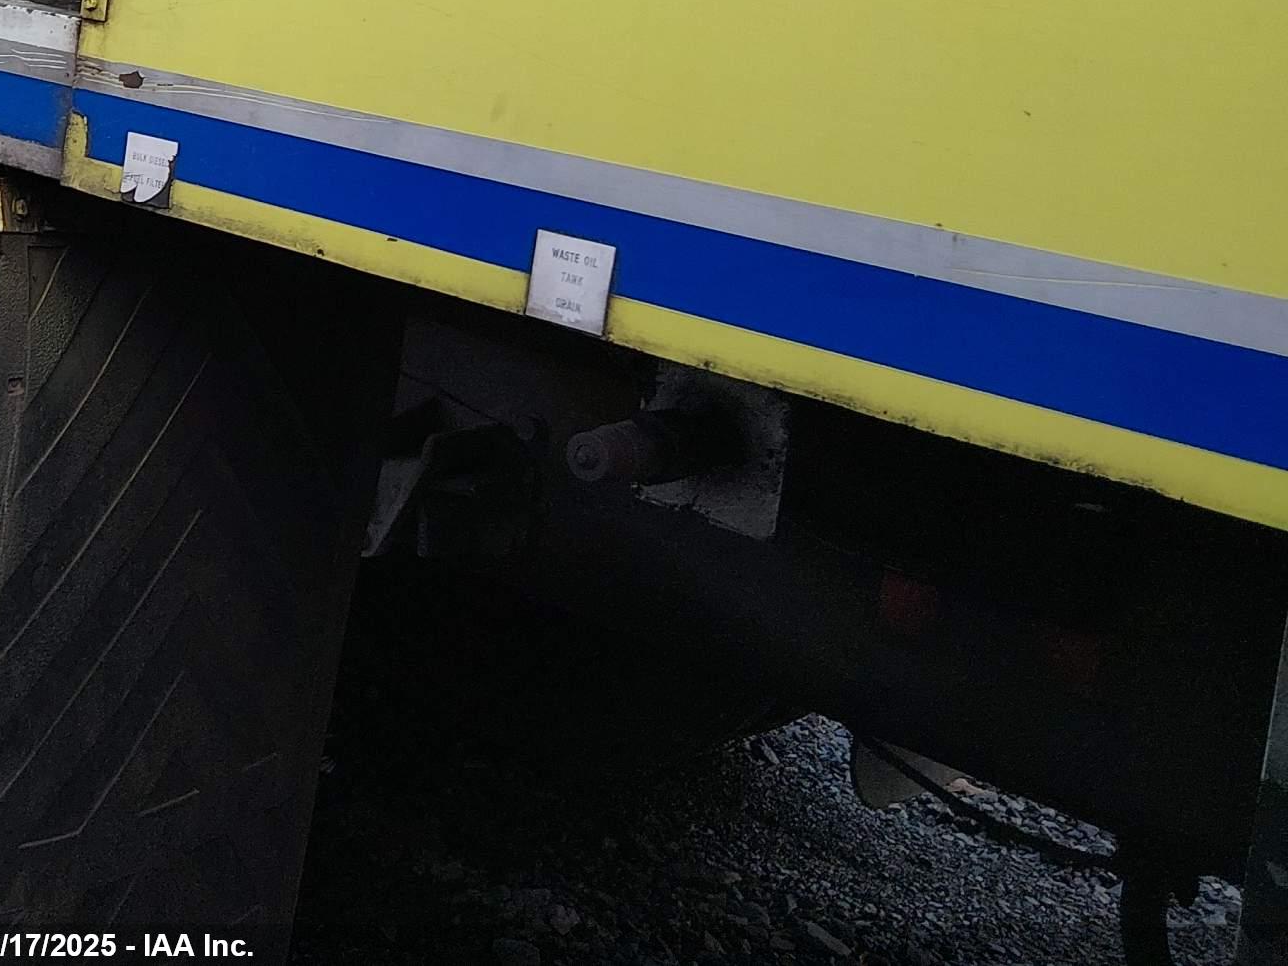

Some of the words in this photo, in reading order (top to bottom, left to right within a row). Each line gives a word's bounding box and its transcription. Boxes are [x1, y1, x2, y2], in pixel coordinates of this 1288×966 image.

[551, 247, 581, 264] WASTE
[583, 255, 599, 269] OIL
[560, 271, 585, 286] TANK
